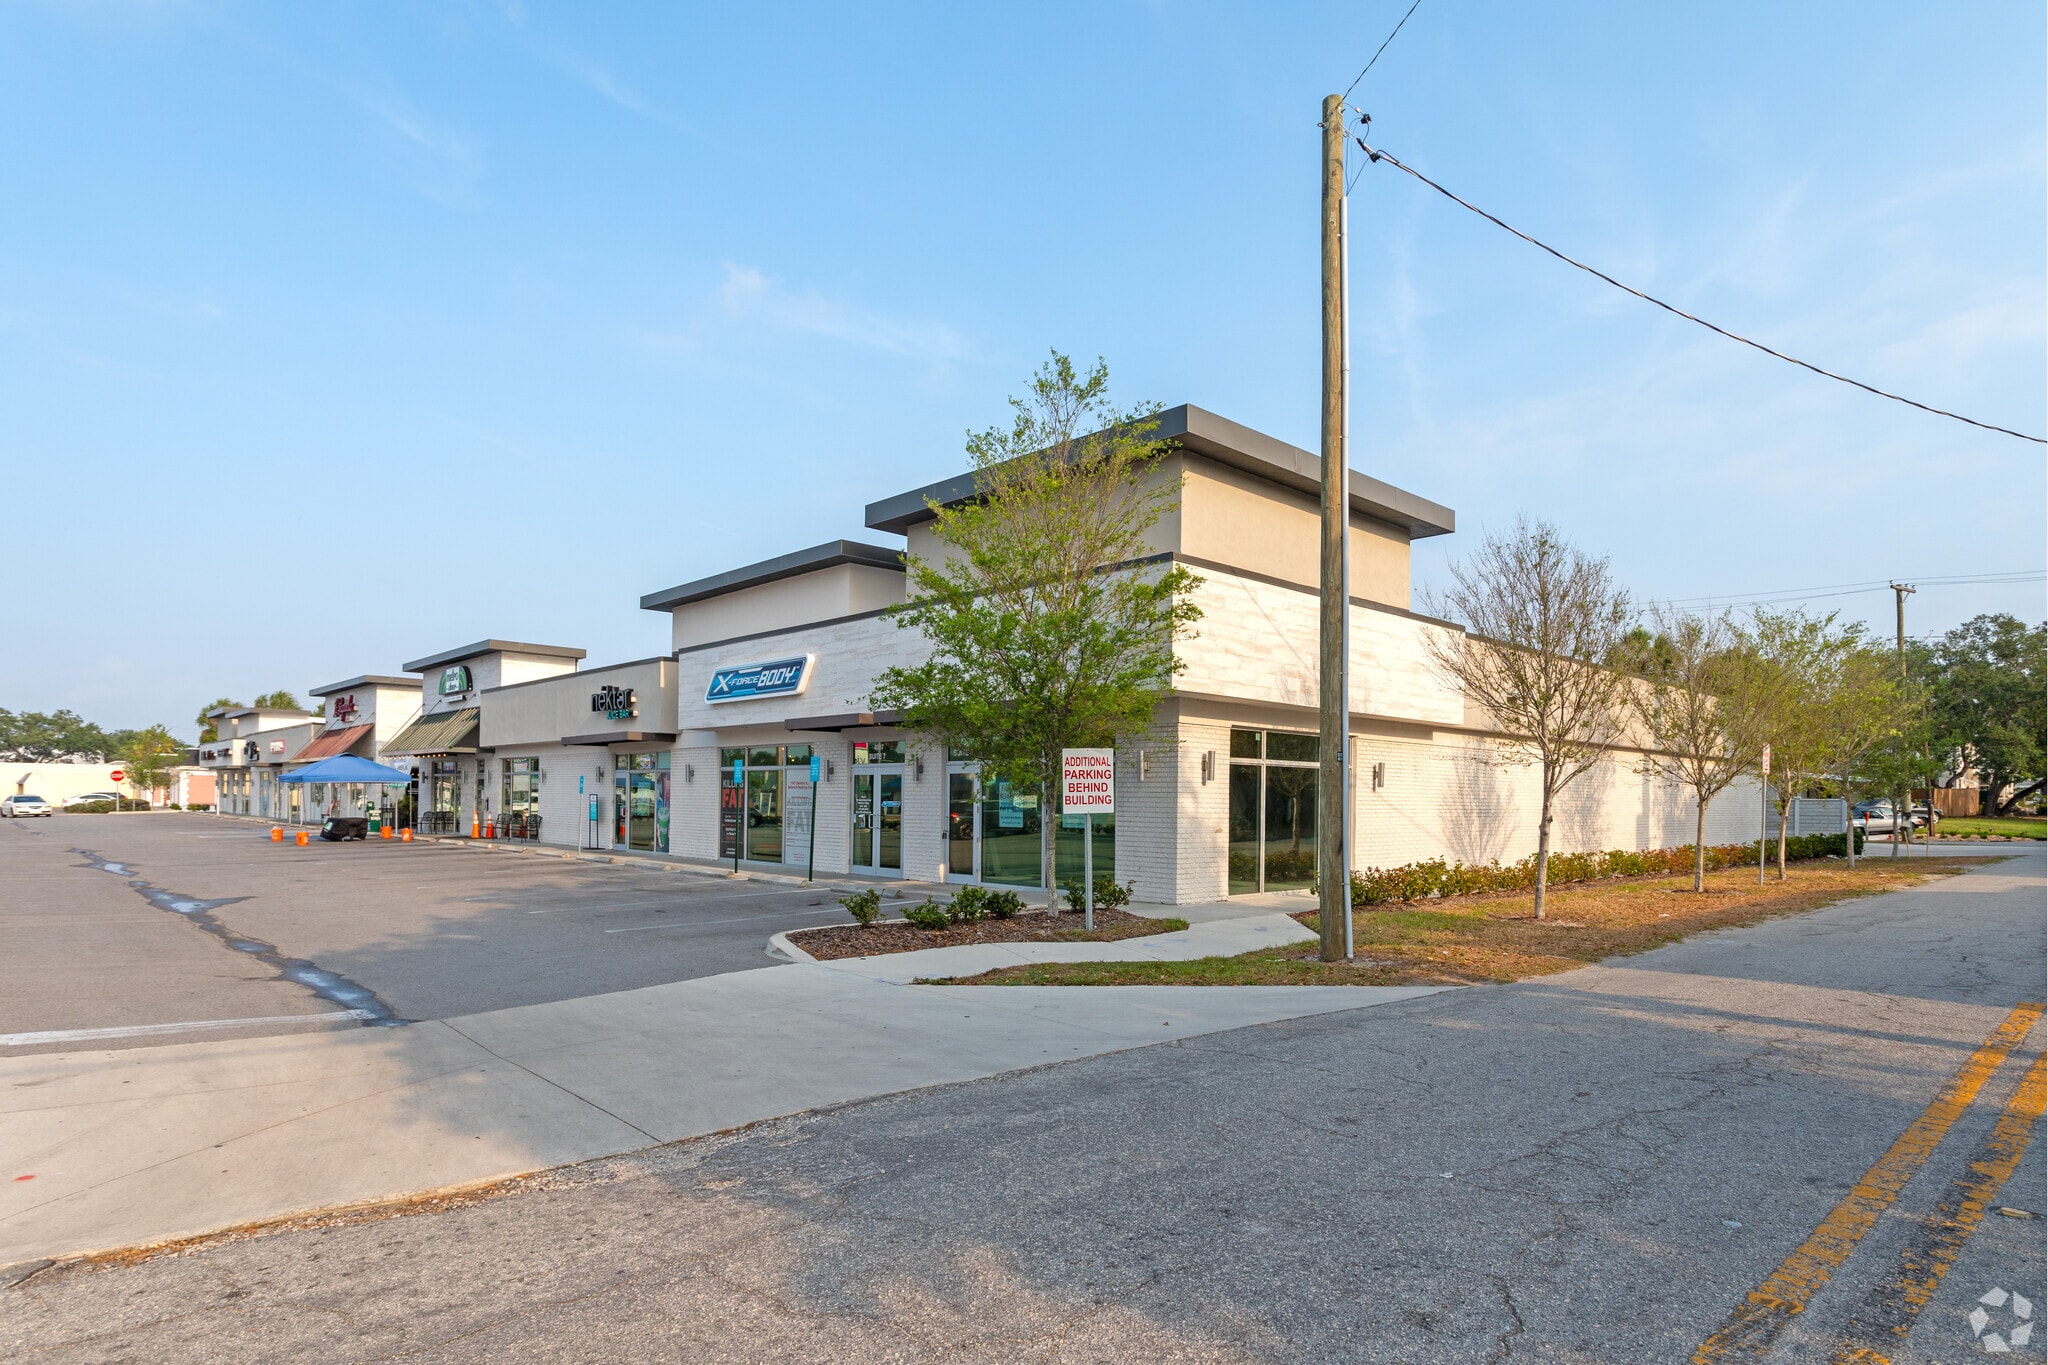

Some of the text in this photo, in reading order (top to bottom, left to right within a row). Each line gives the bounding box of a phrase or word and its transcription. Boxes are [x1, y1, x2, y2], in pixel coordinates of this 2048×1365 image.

[757, 666, 796, 687] BODY
[606, 708, 630, 720] JUICE BAR
[1064, 756, 1112, 767] ADDITIONAL
[1064, 769, 1112, 780] PARKING
[1068, 782, 1109, 793] BEHIND
[1064, 794, 1112, 805] BUILDING
